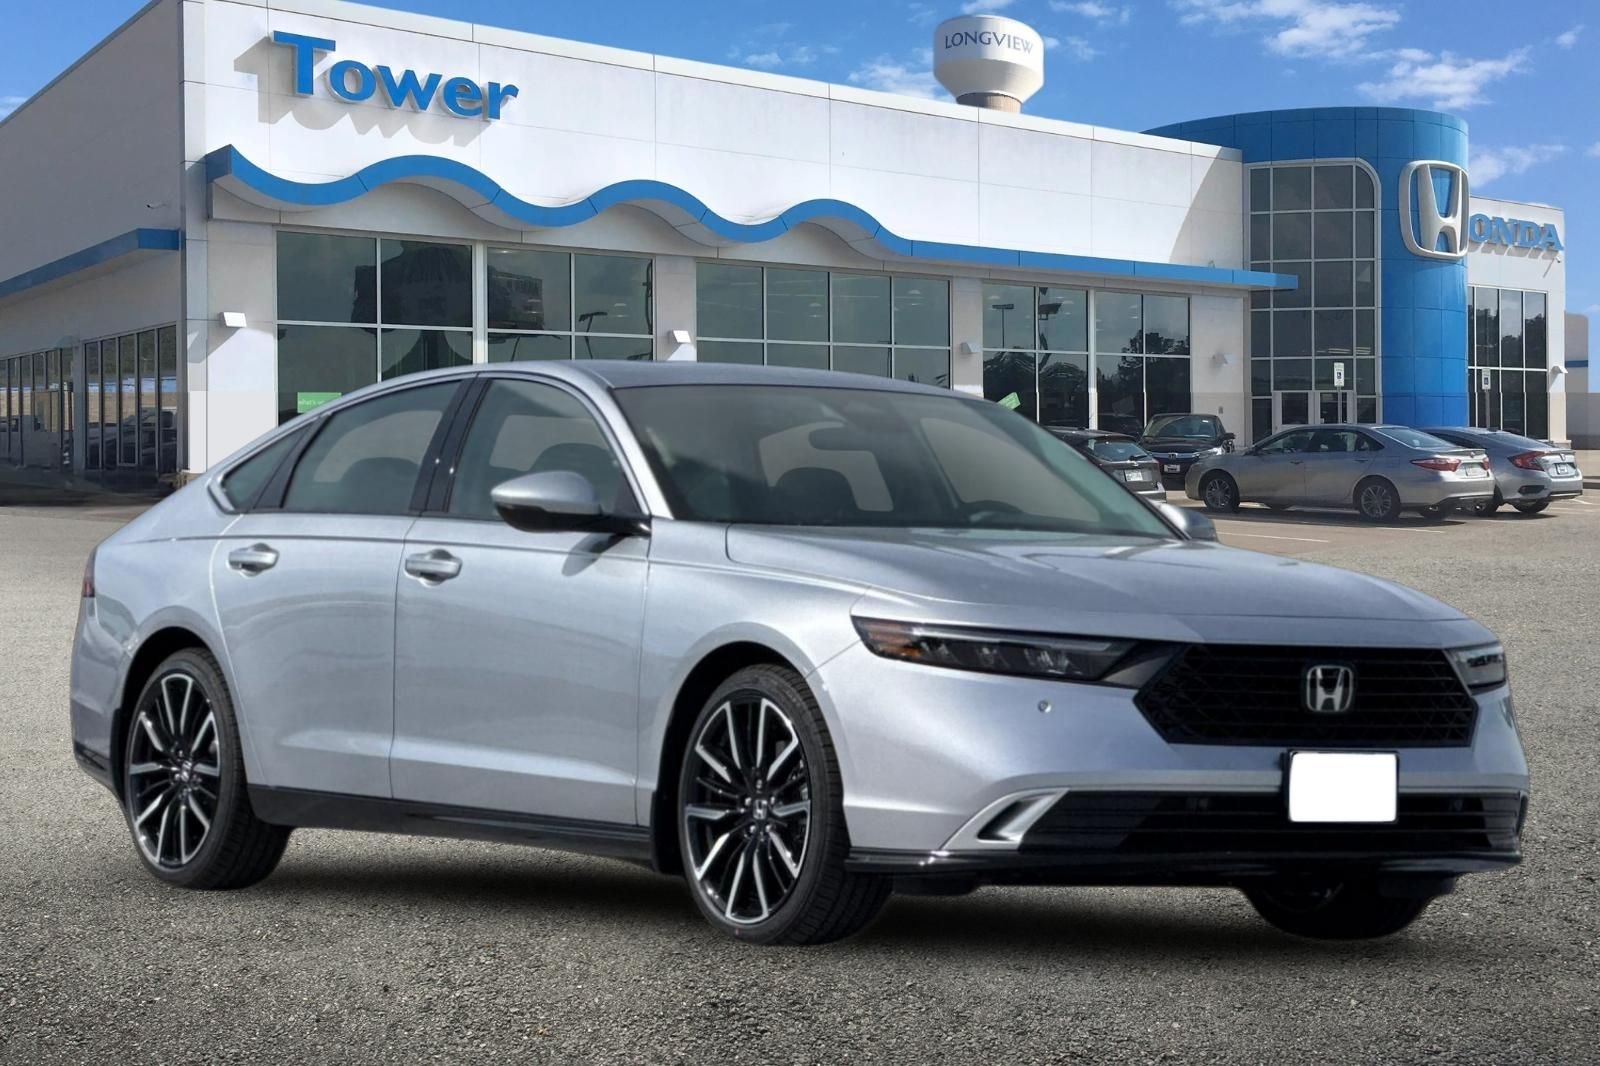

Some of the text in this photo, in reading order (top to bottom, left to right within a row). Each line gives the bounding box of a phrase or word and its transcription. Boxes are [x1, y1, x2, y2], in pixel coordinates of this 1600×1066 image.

[944, 31, 1034, 55] LONGVIEW
[273, 30, 519, 120] Tower
[1469, 213, 1564, 250] ONDA
